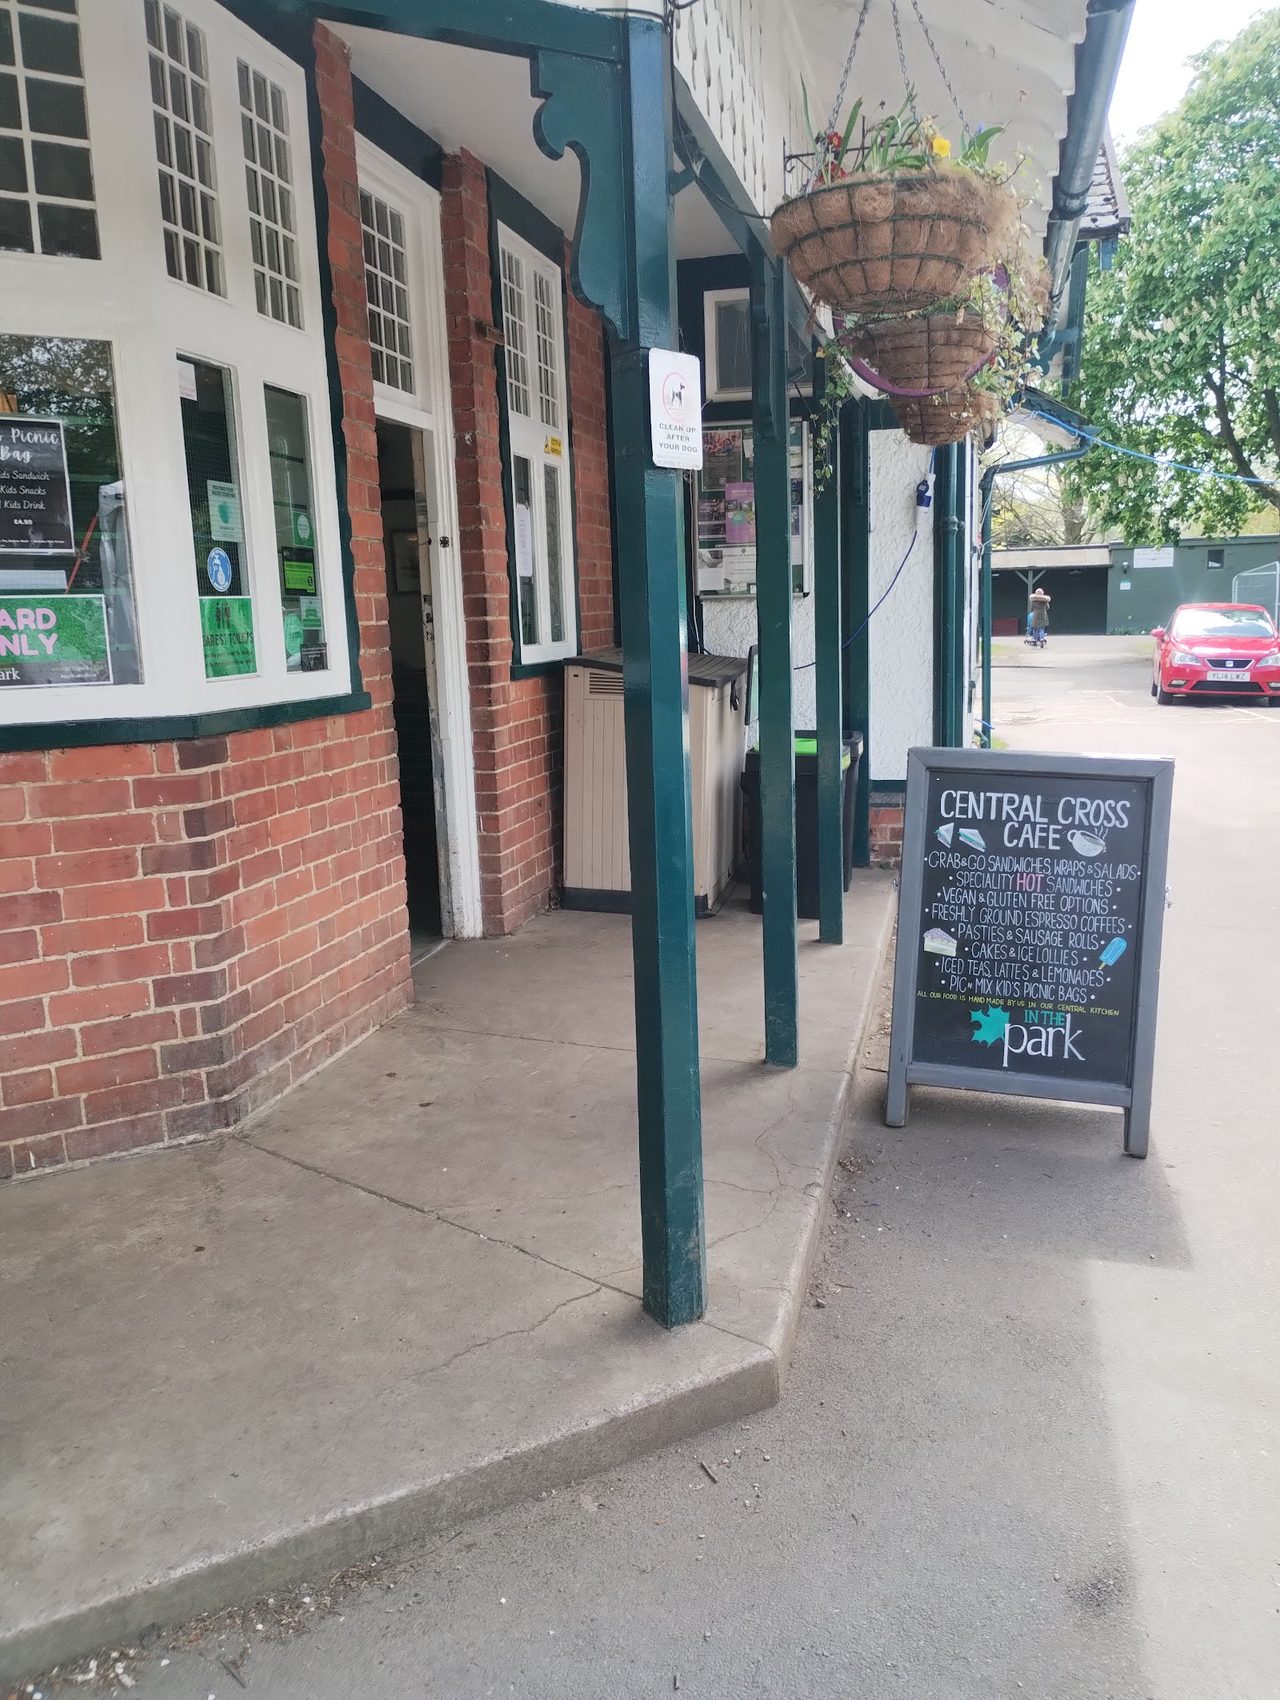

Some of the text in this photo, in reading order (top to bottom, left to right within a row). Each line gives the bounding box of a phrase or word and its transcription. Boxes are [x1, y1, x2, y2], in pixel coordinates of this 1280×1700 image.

[10, 427, 59, 444] Picnic
[659, 423, 696, 434] CLEAN UP
[666, 433, 690, 442] AFTER
[0, 445, 32, 463] Bag
[659, 442, 698, 453] YOUR DOG
[12, 470, 50, 481] Sandwich
[0, 486, 47, 495] Kids Snacks
[4, 500, 46, 510] Kids Drink
[229, 631, 254, 645] TOILETS
[940, 790, 1130, 828] CENTRAL CROSS
[1003, 821, 1062, 850] CAFE
[1054, 859, 1085, 877] WRAPS
[1094, 863, 1137, 880] SALADS
[956, 871, 1113, 897] SPECIALITY HOT SANDWICHES
[942, 886, 976, 905] VEGAN
[986, 891, 1027, 908] GLUTEN
[1031, 893, 1055, 910] FREE
[1060, 895, 1108, 914] OPTIONS
[932, 903, 1125, 934] FRESHLY GROUND ESPRESSO COFFEES
[958, 923, 1004, 943] PASTIES
[1015, 928, 1063, 947] SAUSAGE
[1068, 932, 1098, 950] ROLLS
[971, 941, 1007, 960] CAKES
[1017, 946, 1034, 962] ICE
[1036, 947, 1078, 966] LOLLIES
[940, 956, 964, 974] ICED
[994, 962, 1029, 980] LATTES
[1041, 965, 1104, 987] LEMONADES
[949, 974, 967, 992] PIC
[975, 977, 993, 995] MIX
[995, 979, 1020, 997] KID'S
[1023, 982, 1055, 1001] PICNIC
[1058, 985, 1087, 1003] BAGS
[917, 990, 927, 998] ALL
[942, 992, 957, 1000] FOOD
[1057, 1004, 1086, 1013] CENTRAL
[1090, 1006, 1120, 1016] KITCHEN
[1024, 1009, 1065, 1026] IN THE
[1002, 1013, 1086, 1068] park
